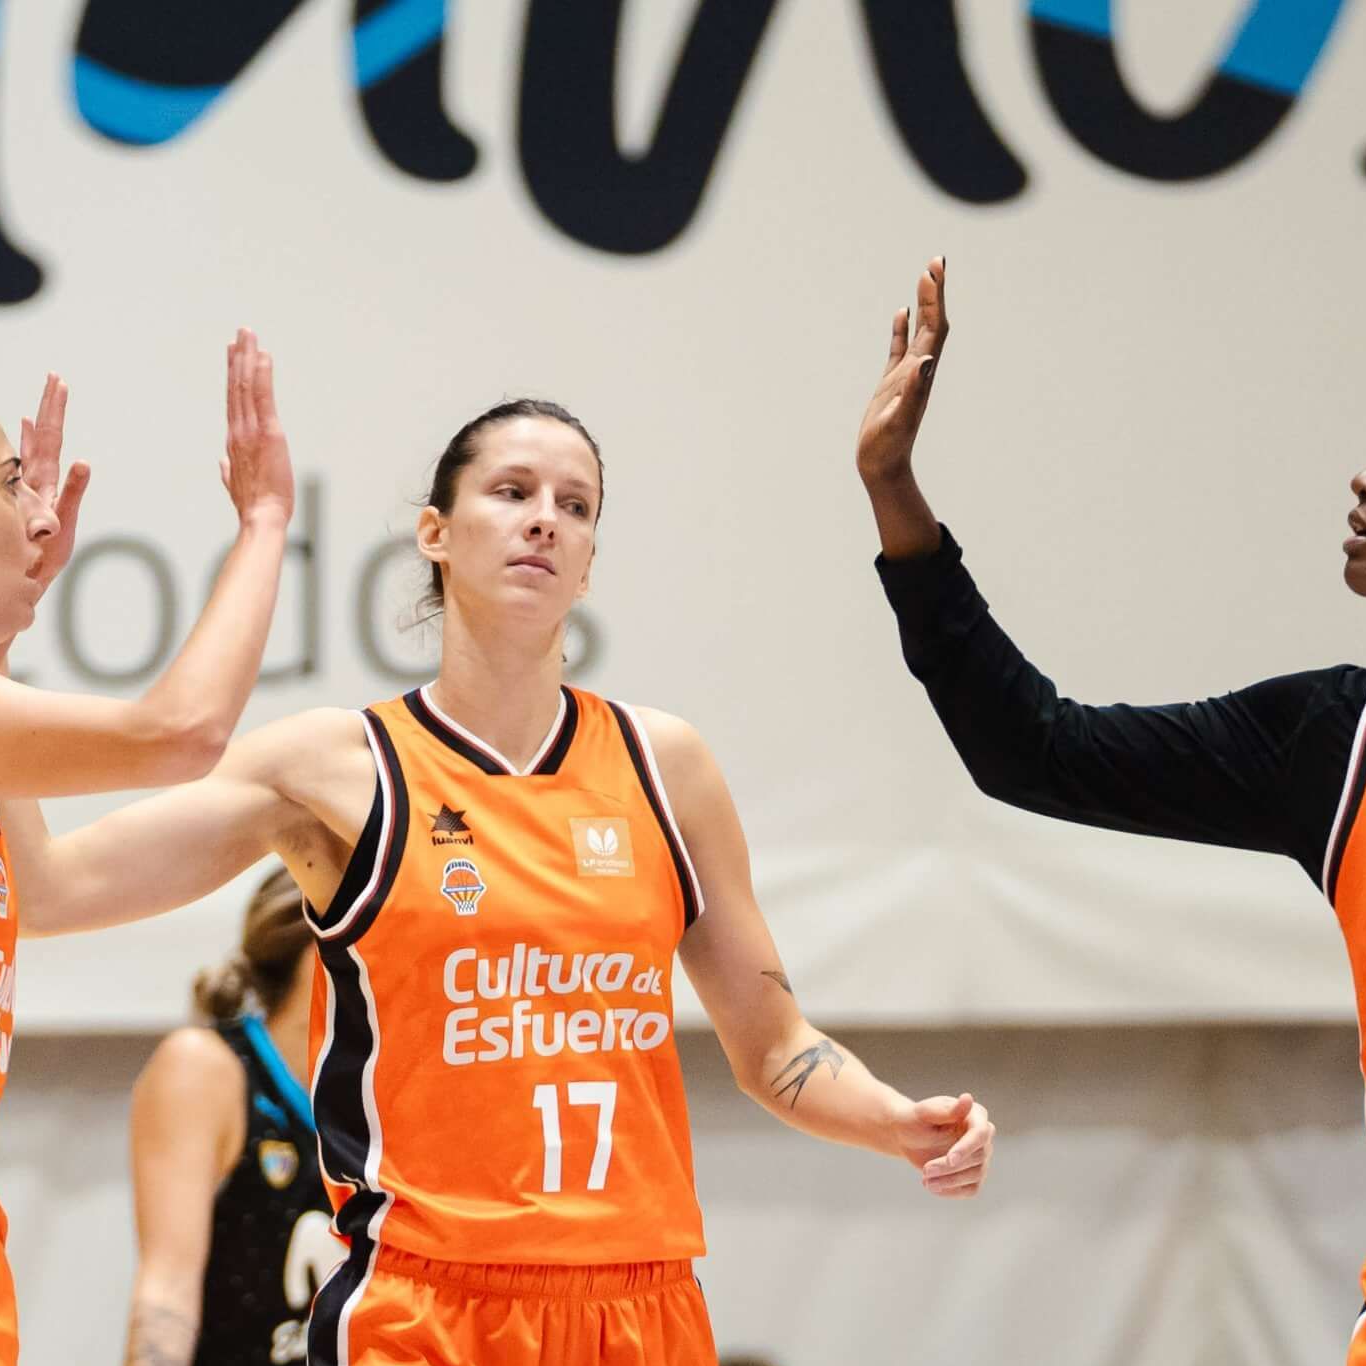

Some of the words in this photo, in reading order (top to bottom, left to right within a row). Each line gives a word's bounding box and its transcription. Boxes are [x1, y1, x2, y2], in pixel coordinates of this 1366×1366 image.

[442, 943, 635, 1003] Cultura
[442, 1007, 669, 1065] Esfuerzo
[532, 1081, 618, 1193] 17
